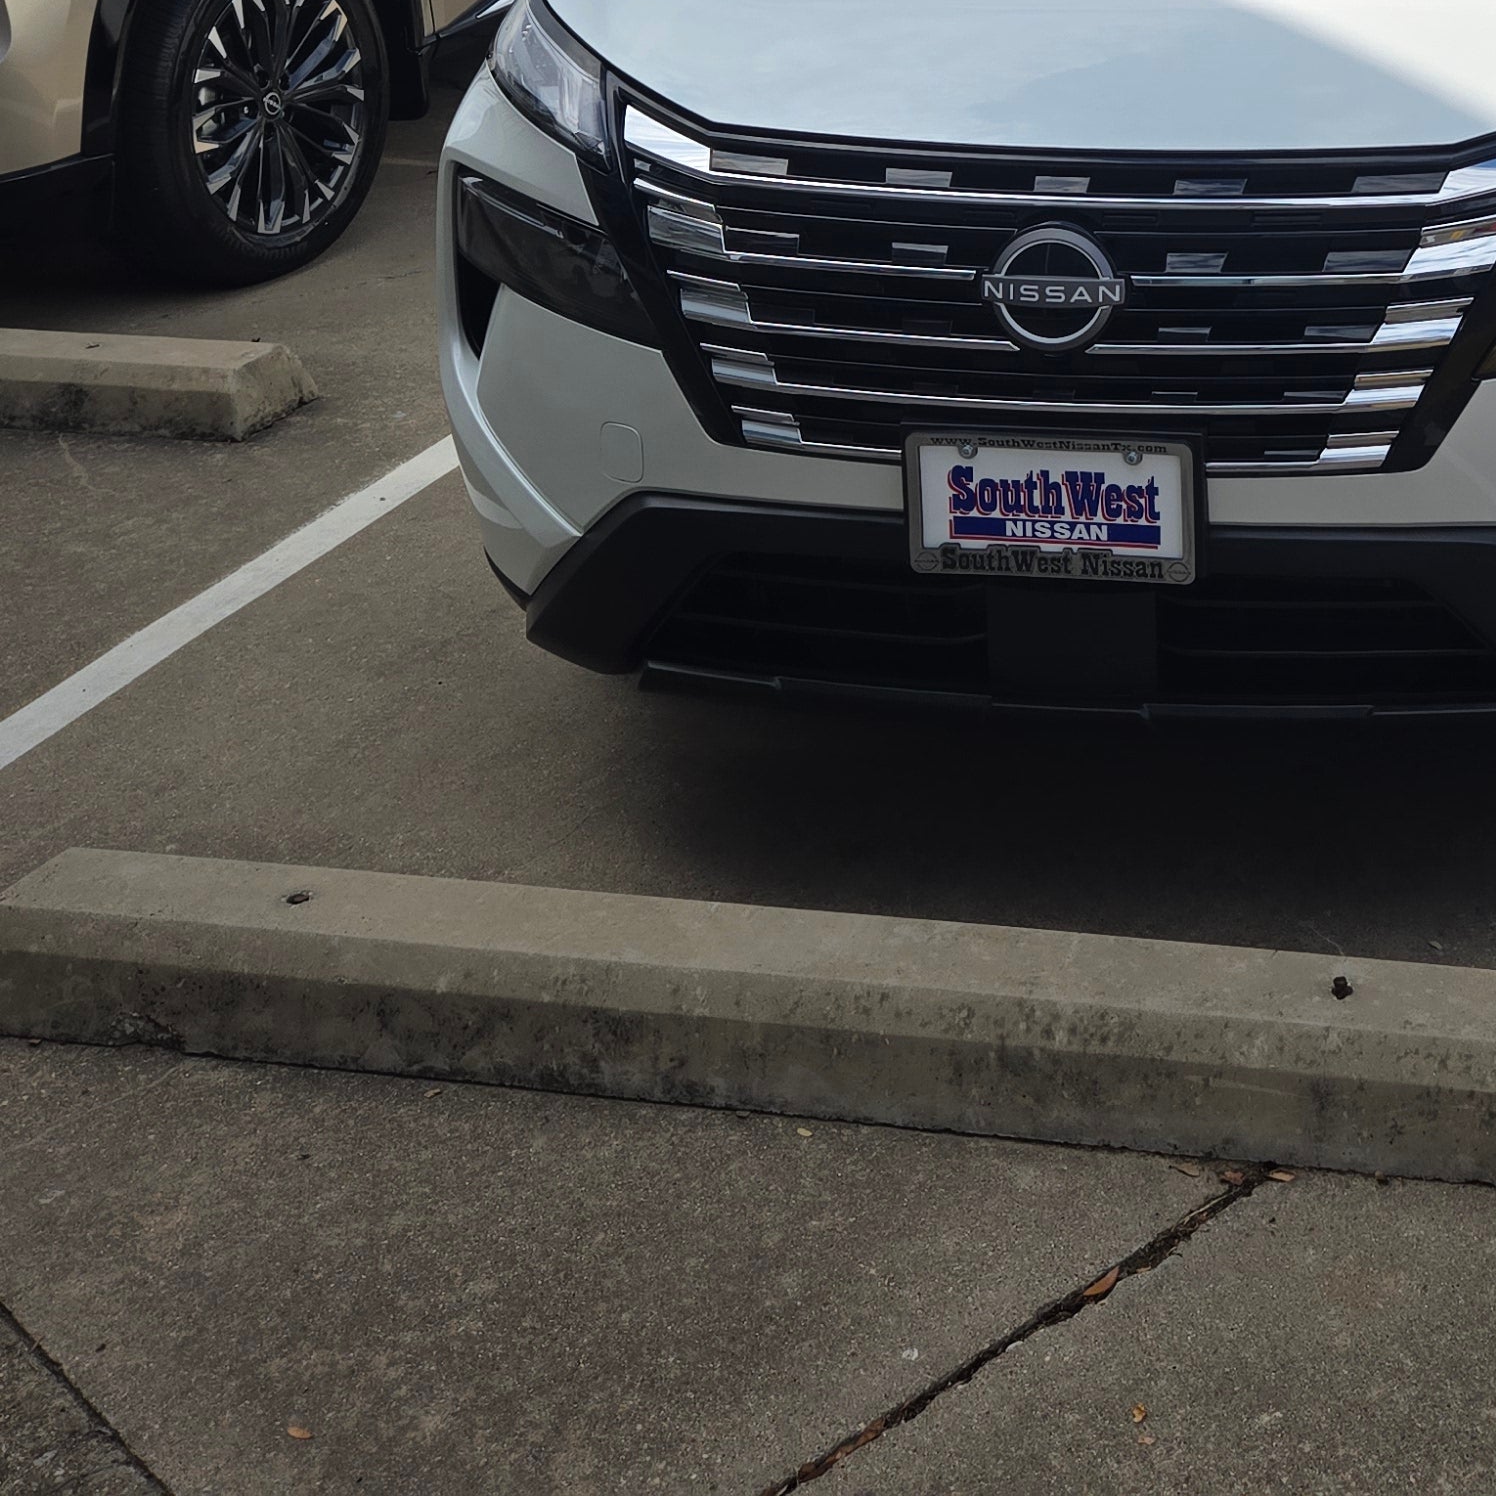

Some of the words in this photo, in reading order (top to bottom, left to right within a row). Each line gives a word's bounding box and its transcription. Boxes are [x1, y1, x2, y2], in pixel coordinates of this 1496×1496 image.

[984, 280, 1121, 303] NISSAN
[930, 436, 1168, 454] www.SouthWestNissanTx.com
[947, 465, 1161, 524] SouthWest
[1005, 520, 1109, 542] NISSAN
[941, 547, 1072, 575] SouthWest
[1081, 552, 1165, 579] Nissan
